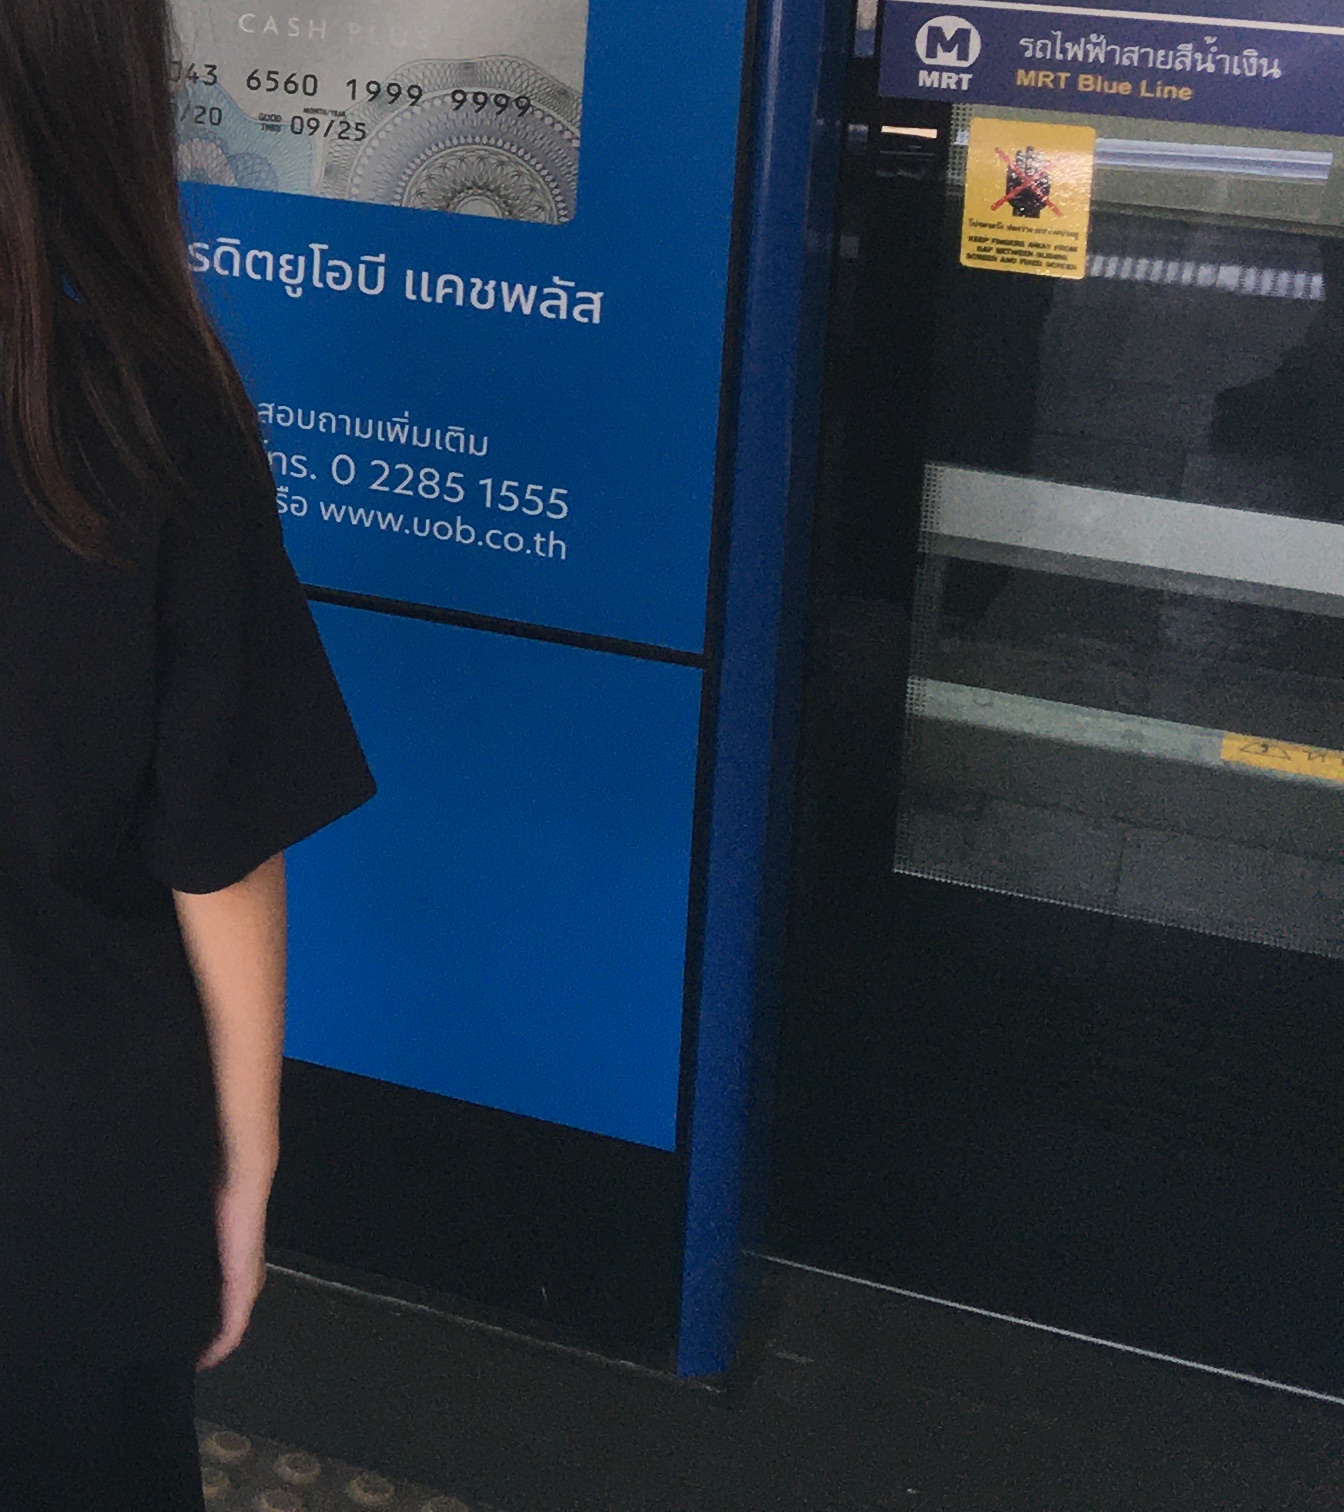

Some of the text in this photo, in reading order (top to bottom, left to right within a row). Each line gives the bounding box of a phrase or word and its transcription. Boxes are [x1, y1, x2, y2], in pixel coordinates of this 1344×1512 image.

[238, 12, 327, 40] CASH
[917, 69, 973, 91] MRT
[1018, 30, 1283, 80] รถไฟฟ้าสายสีน้ำเงิน
[246, 68, 319, 97] 6560
[346, 78, 423, 108] 1999
[451, 89, 534, 119] 9999
[1016, 68, 1194, 101] MRT Blue Line
[289, 114, 368, 143] 09/25
[404, 267, 605, 325] แคชพลัส
[257, 401, 489, 458] สอบถามเพิ่มเติม
[264, 440, 570, 521] ทร. 0 2285 1555
[319, 500, 567, 561] www.uob.co.th
